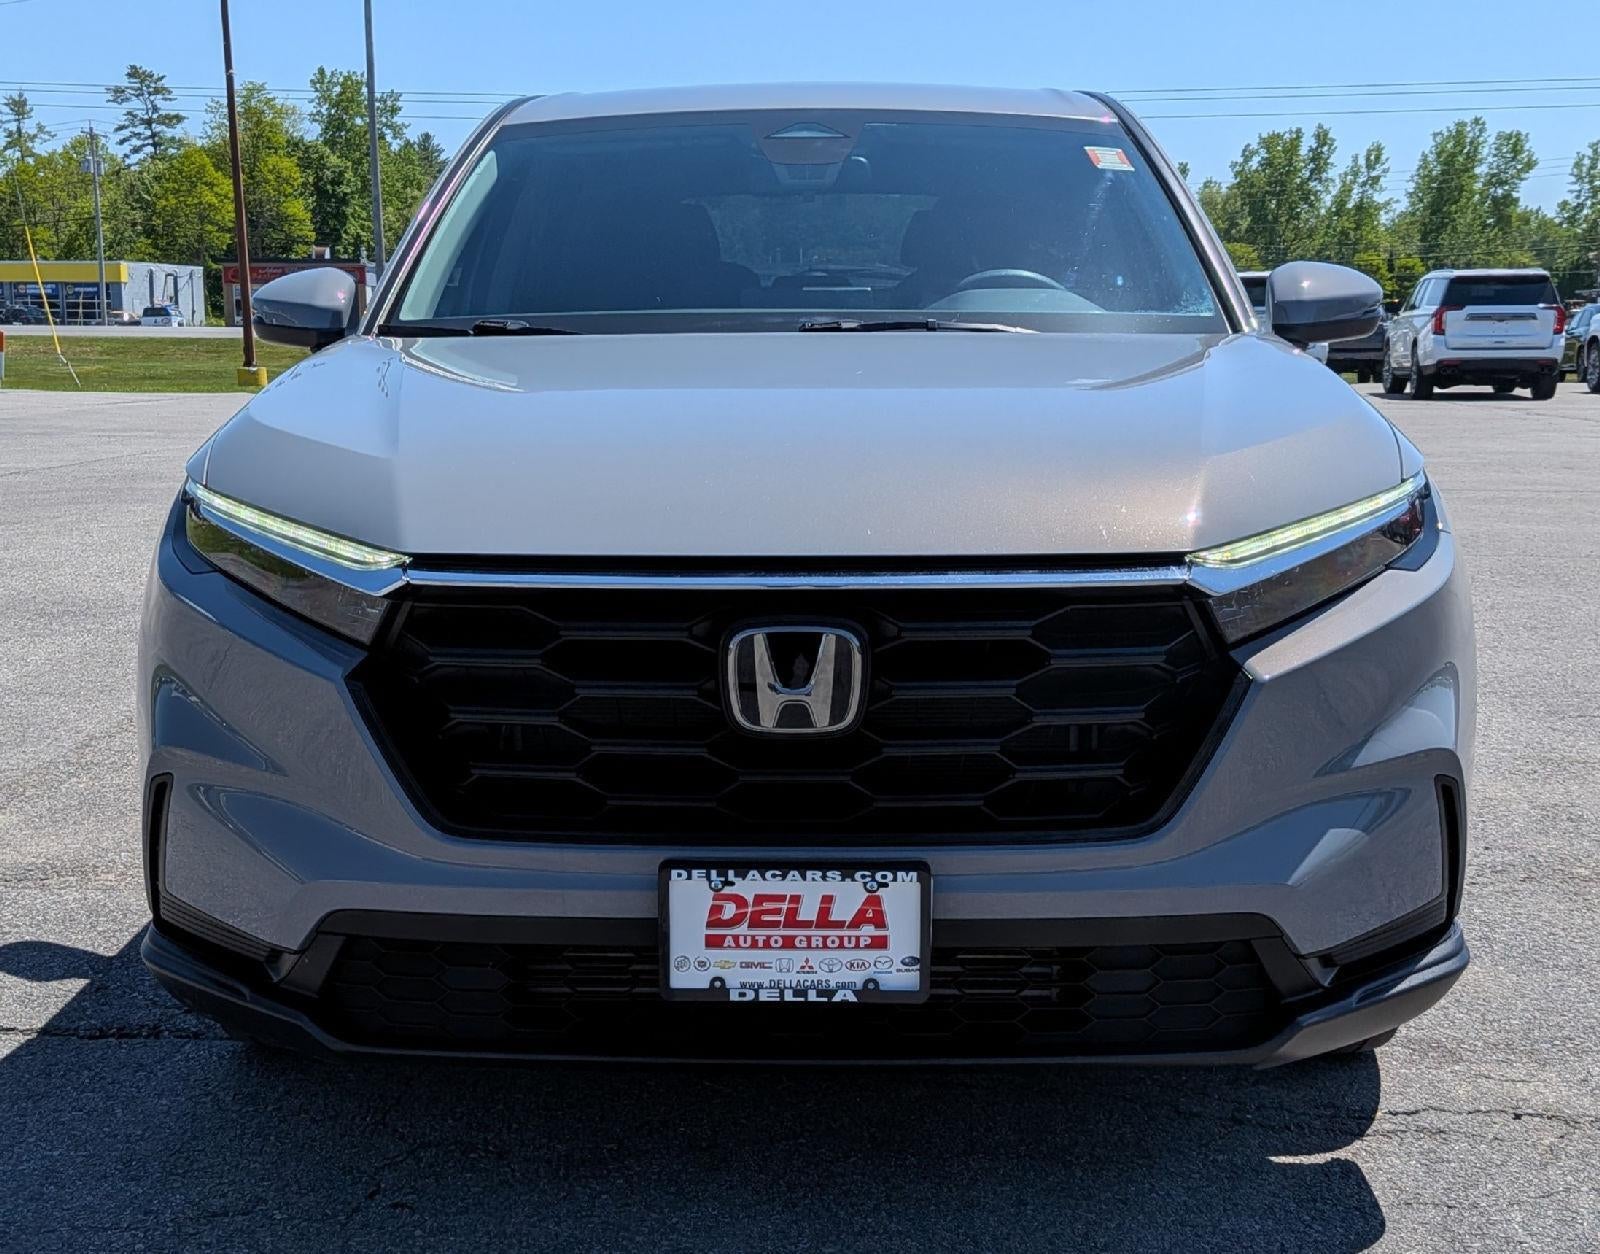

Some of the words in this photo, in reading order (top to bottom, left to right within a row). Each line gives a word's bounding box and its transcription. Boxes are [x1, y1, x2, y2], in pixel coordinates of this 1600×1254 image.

[670, 869, 918, 882] DELLACARS.COM
[705, 892, 889, 931] DELLA
[723, 936, 783, 948] AUTO
[795, 936, 872, 948] GROUP
[849, 961, 868, 970] KIA
[729, 988, 858, 1001] DELLA
